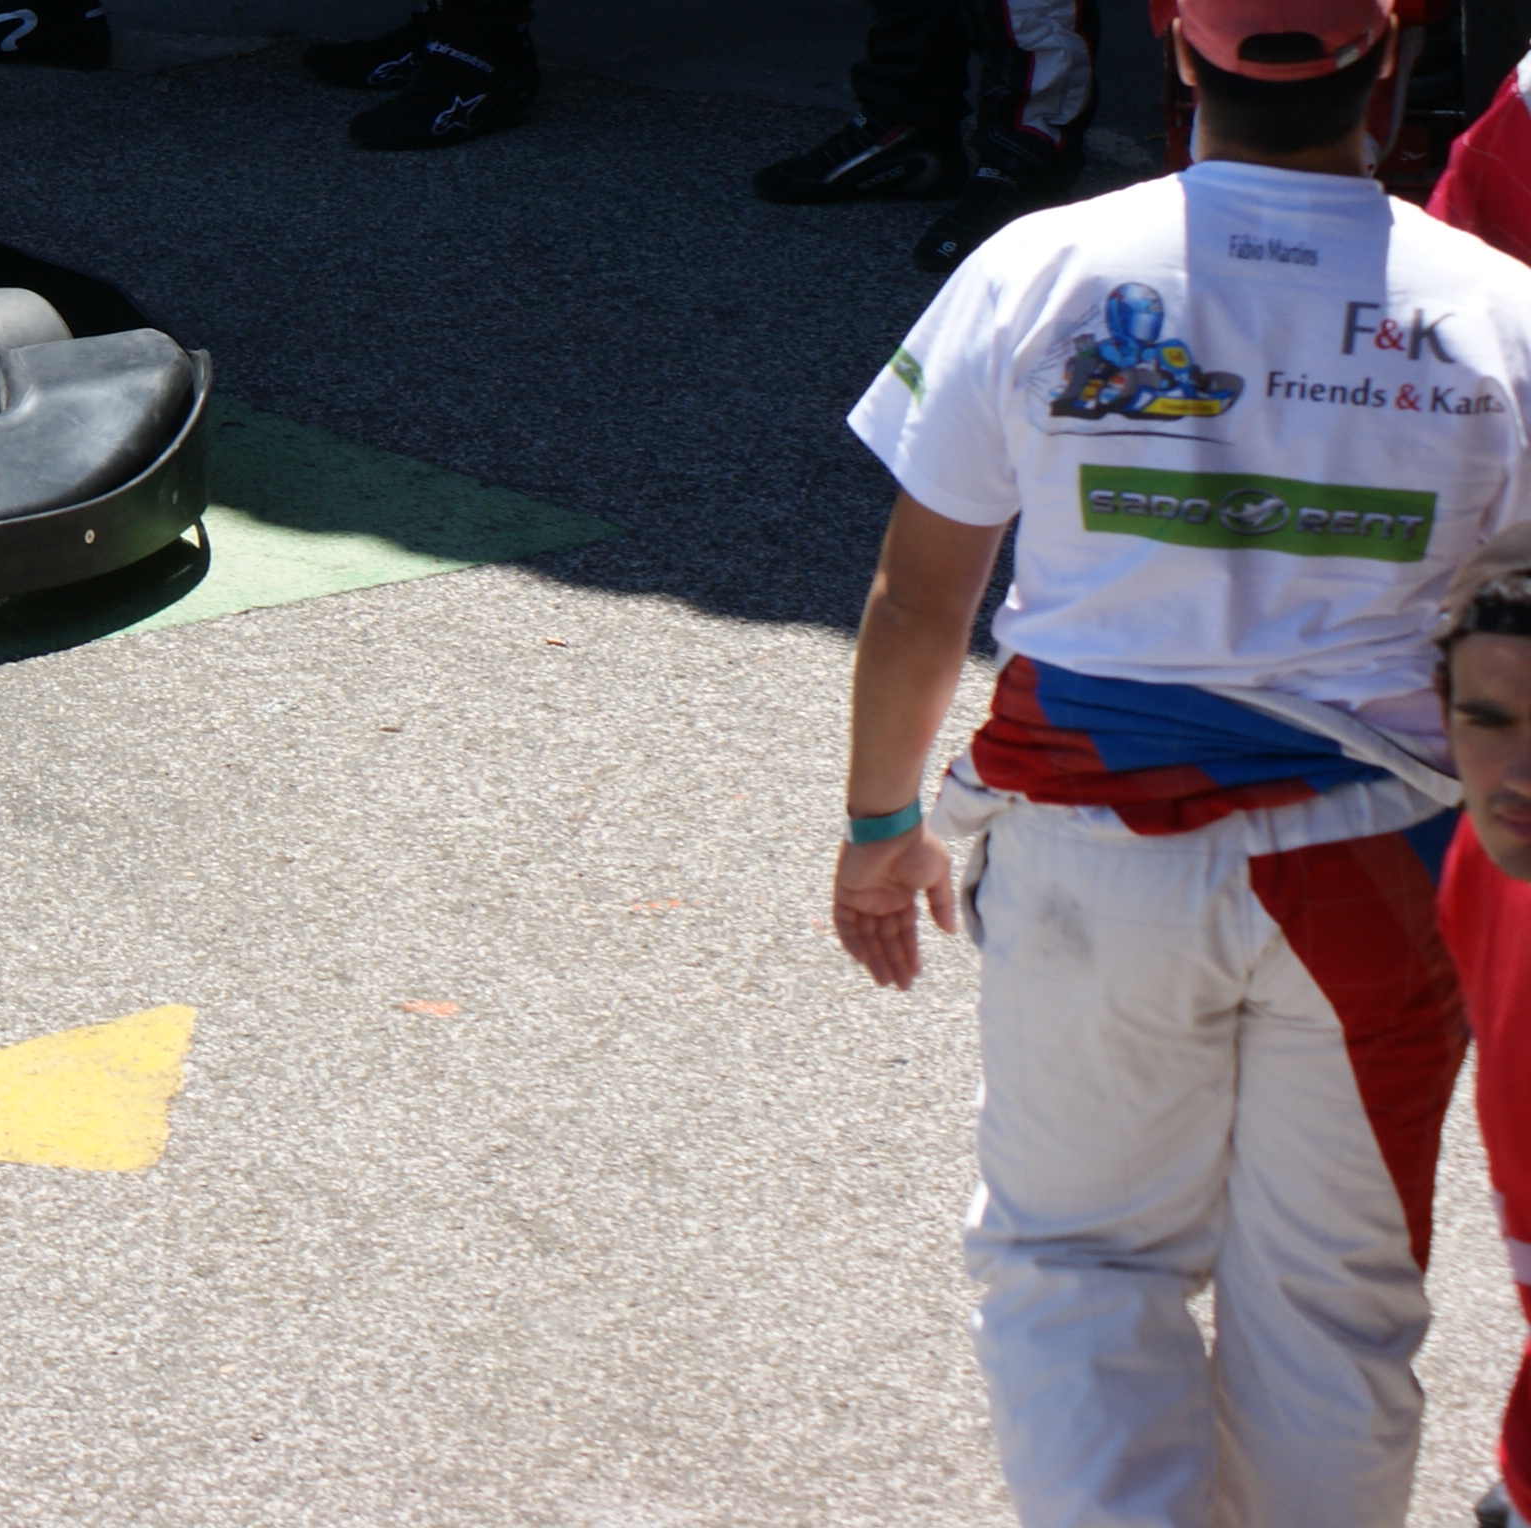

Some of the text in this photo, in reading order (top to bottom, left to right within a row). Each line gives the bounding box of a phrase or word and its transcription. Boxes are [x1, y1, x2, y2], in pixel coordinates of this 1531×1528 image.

[1267, 238, 1318, 267] Martins
[1341, 301, 1456, 364] F&K
[1265, 369, 1387, 408] Friends
[1394, 383, 1422, 412] &
